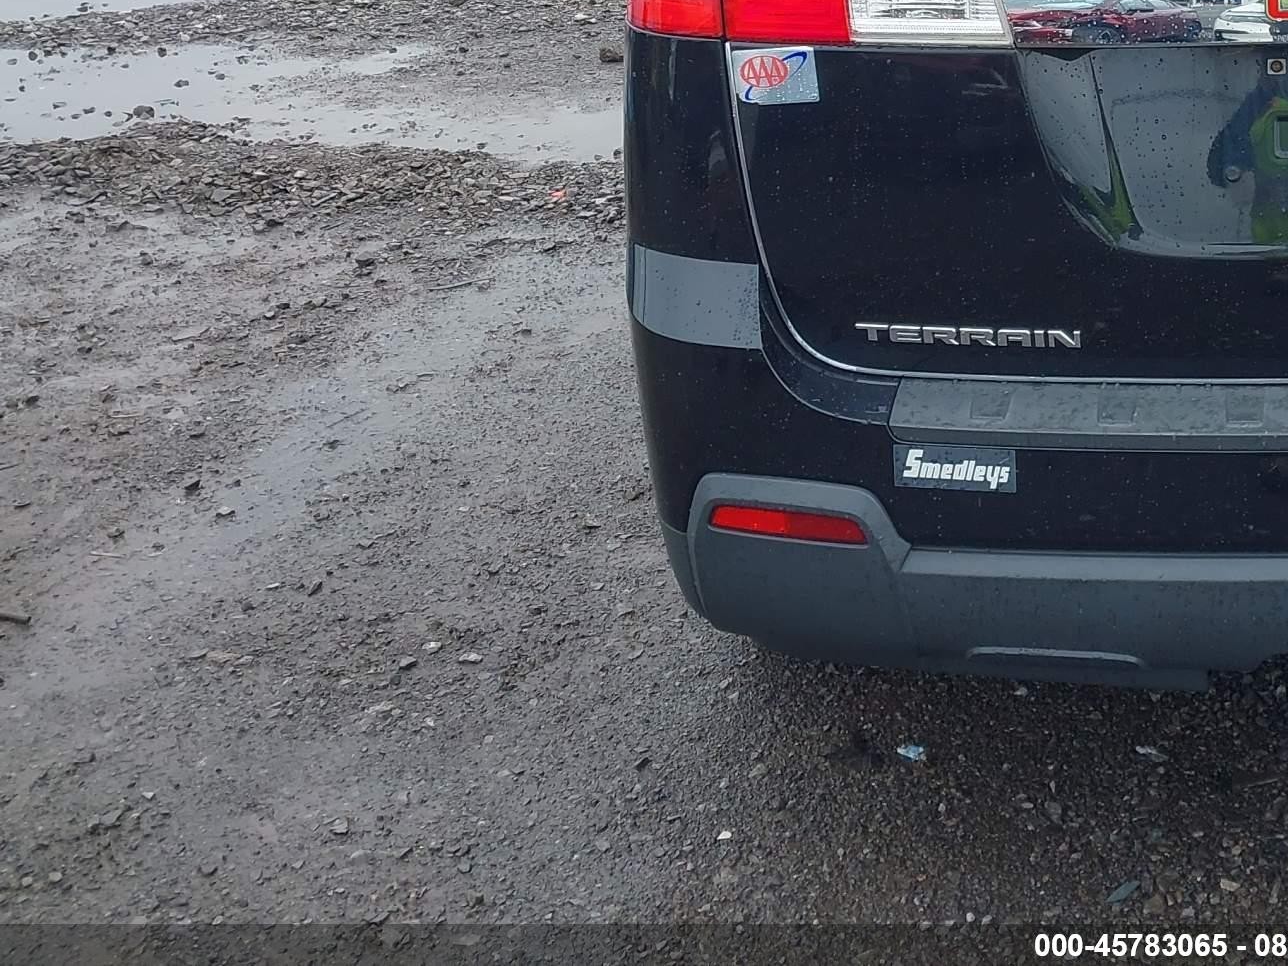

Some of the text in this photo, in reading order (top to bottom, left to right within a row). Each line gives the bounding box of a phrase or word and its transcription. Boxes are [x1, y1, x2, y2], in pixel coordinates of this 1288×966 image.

[741, 56, 787, 87] AAA
[855, 322, 1082, 348] TERRAIN
[903, 449, 1010, 489] Smedleys
